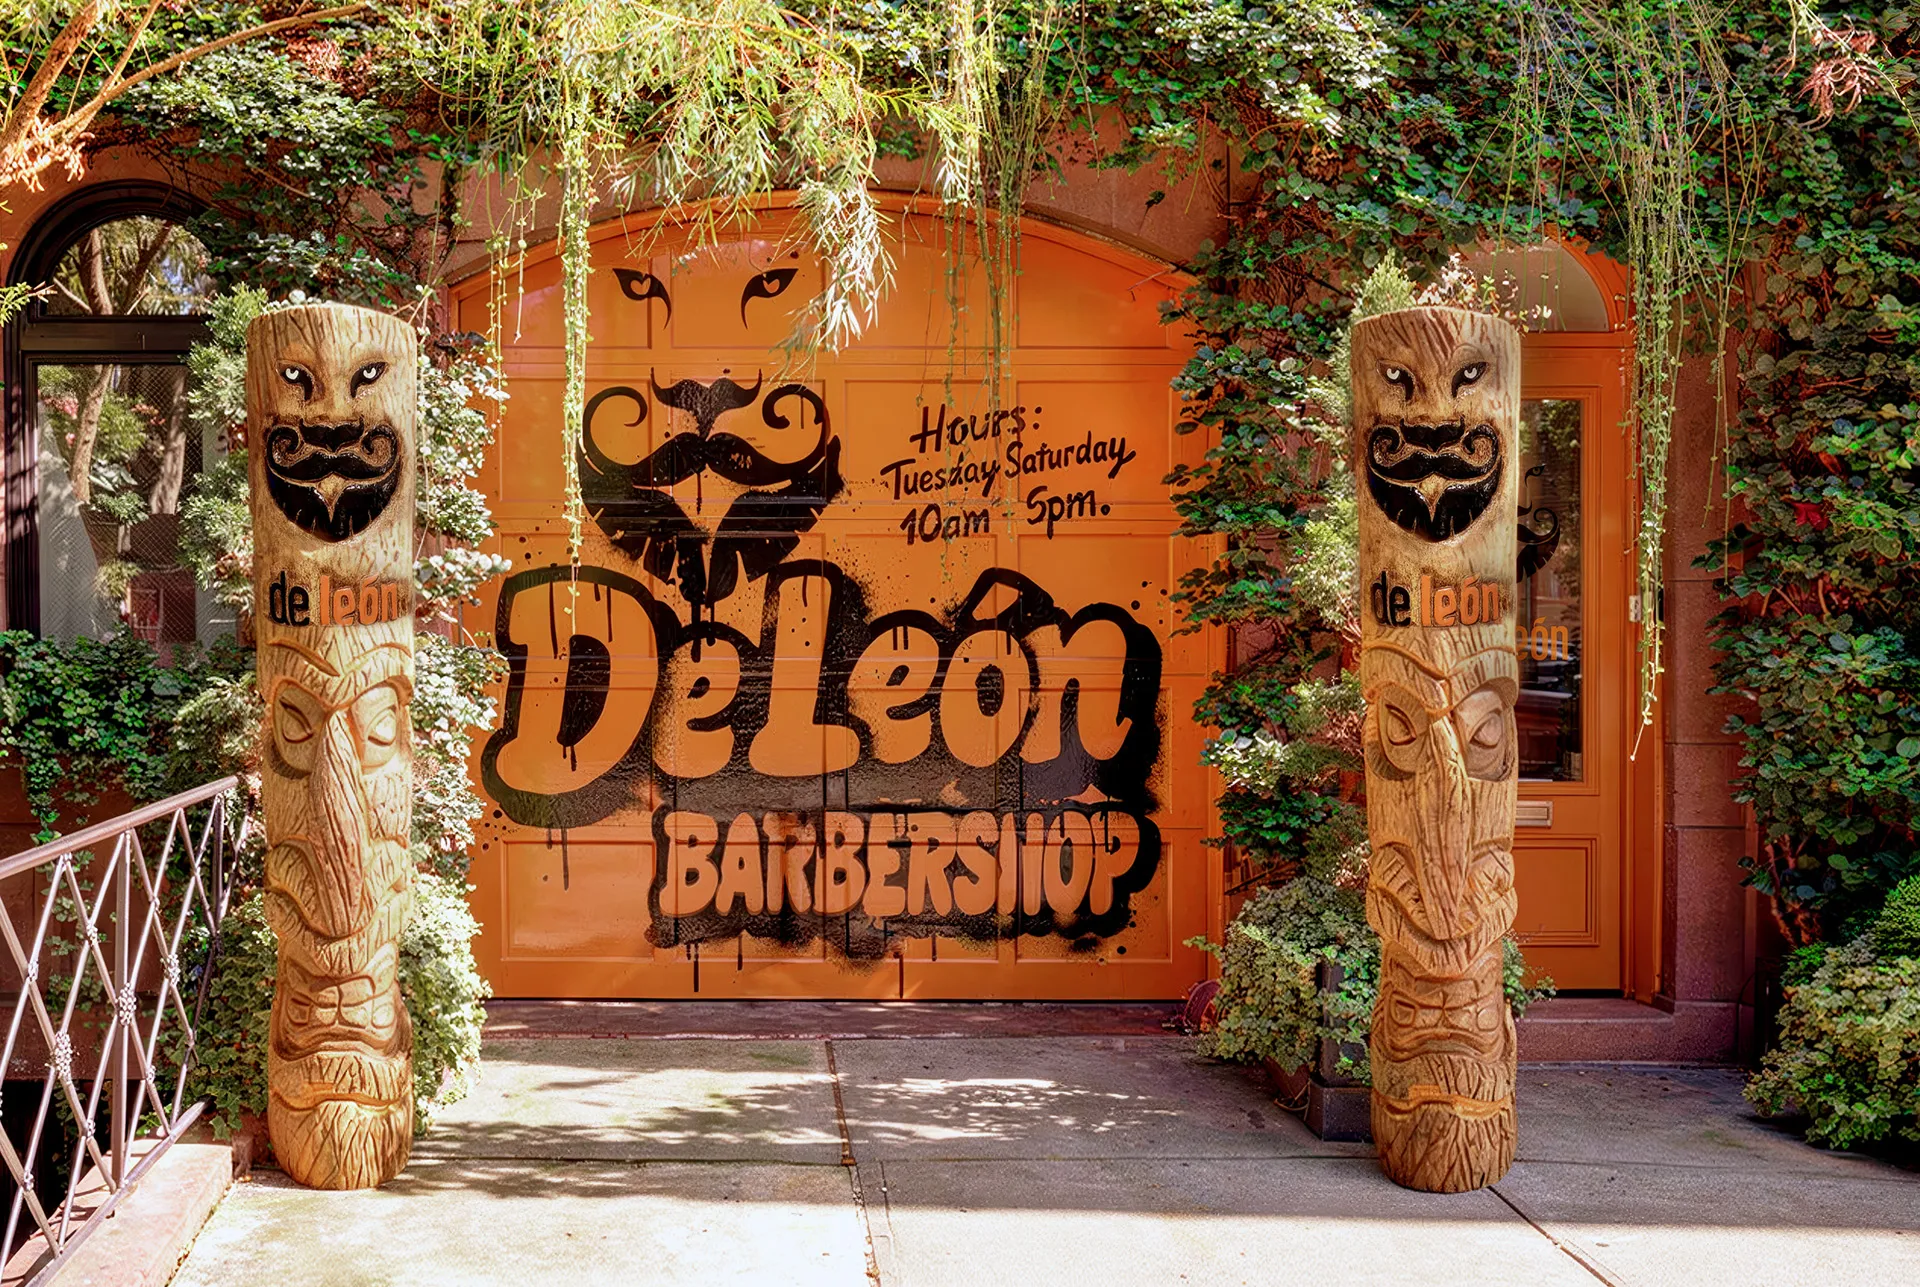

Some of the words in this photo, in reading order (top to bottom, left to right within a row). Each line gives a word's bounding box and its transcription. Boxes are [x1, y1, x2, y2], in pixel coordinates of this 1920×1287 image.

[909, 403, 1042, 453] Hours:
[880, 453, 1001, 500] Tuesday
[1005, 430, 1136, 479] Saturday
[900, 503, 990, 545] 10am
[269, 570, 310, 626] de
[319, 572, 398, 626] león
[1370, 570, 1411, 627] de
[1420, 573, 1500, 627] león
[1516, 616, 1569, 661] eón
[656, 811, 1140, 917] BARBERSHOP
